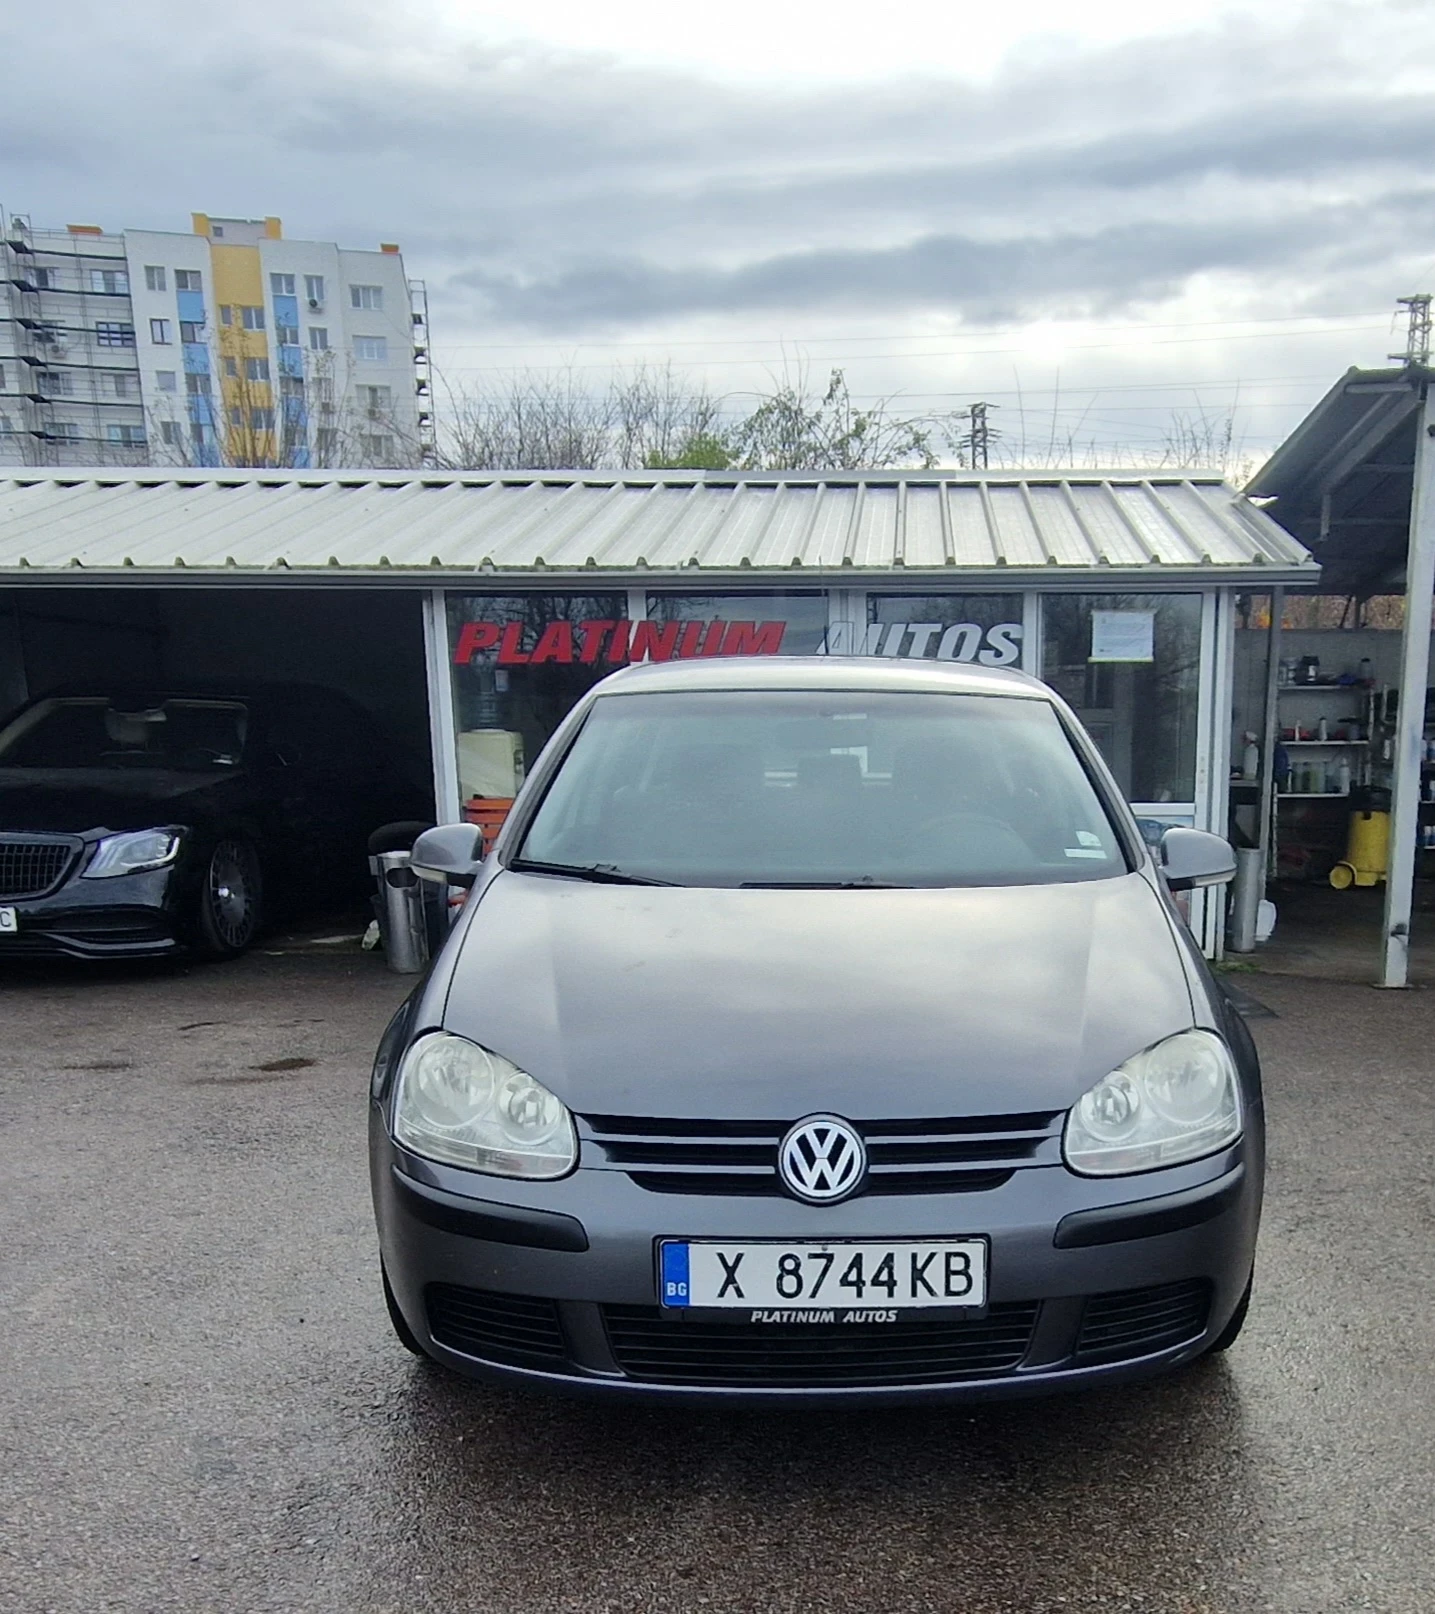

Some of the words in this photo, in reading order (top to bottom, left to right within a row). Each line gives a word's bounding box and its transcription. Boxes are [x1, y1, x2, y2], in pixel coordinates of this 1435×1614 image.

[453, 620, 787, 664] PLATINUM
[815, 621, 1024, 666] AUTOS
[666, 1282, 687, 1297] BG
[716, 1252, 745, 1299] X
[750, 1310, 836, 1324] PLATINUM
[842, 1309, 898, 1323] AUTOS
